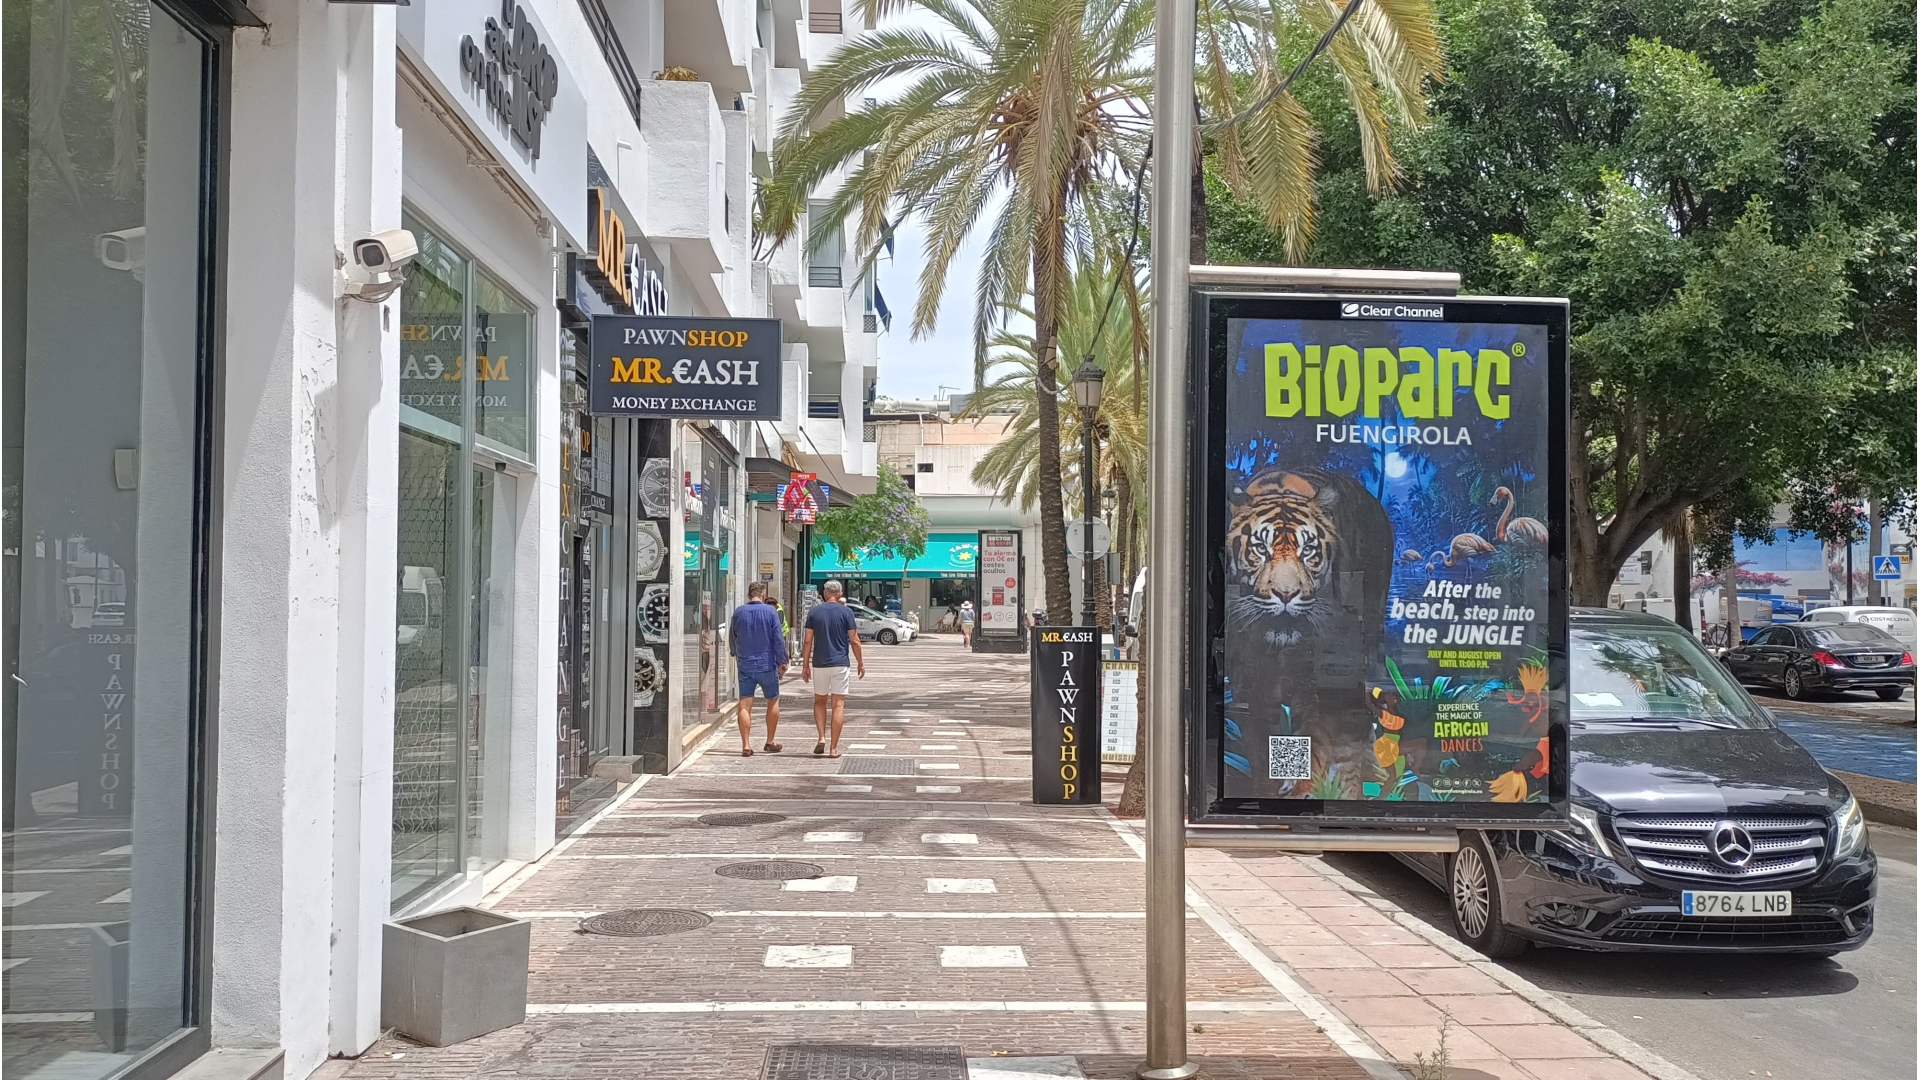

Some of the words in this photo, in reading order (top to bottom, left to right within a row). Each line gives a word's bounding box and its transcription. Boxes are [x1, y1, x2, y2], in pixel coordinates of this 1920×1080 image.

[1361, 304, 1393, 317] Clear
[1394, 305, 1444, 318] Channel
[623, 328, 749, 347] PAWNSHOP
[611, 397, 669, 410] MONEY
[671, 398, 757, 411] EXCHANGE
[1316, 424, 1472, 446] FUENGIROLA
[1423, 580, 1472, 598] After
[1475, 582, 1502, 599] the
[1390, 598, 1459, 622] beach,
[1463, 604, 1499, 623] step
[1502, 605, 1536, 622] into
[1403, 623, 1438, 643] the
[1442, 625, 1525, 646] JUNGLE
[1427, 650, 1441, 658] JULY
[1443, 650, 1457, 658] AND
[1458, 651, 1482, 659] AUGUST
[1438, 703, 1480, 712] EXPERIENCE
[1450, 712, 1472, 720] MAGIC
[1056, 651, 1080, 800] PAWNSHOP
[1441, 738, 1484, 752] DANCES
[1696, 896, 1745, 912] 8764
[1752, 895, 1787, 912] LNB
